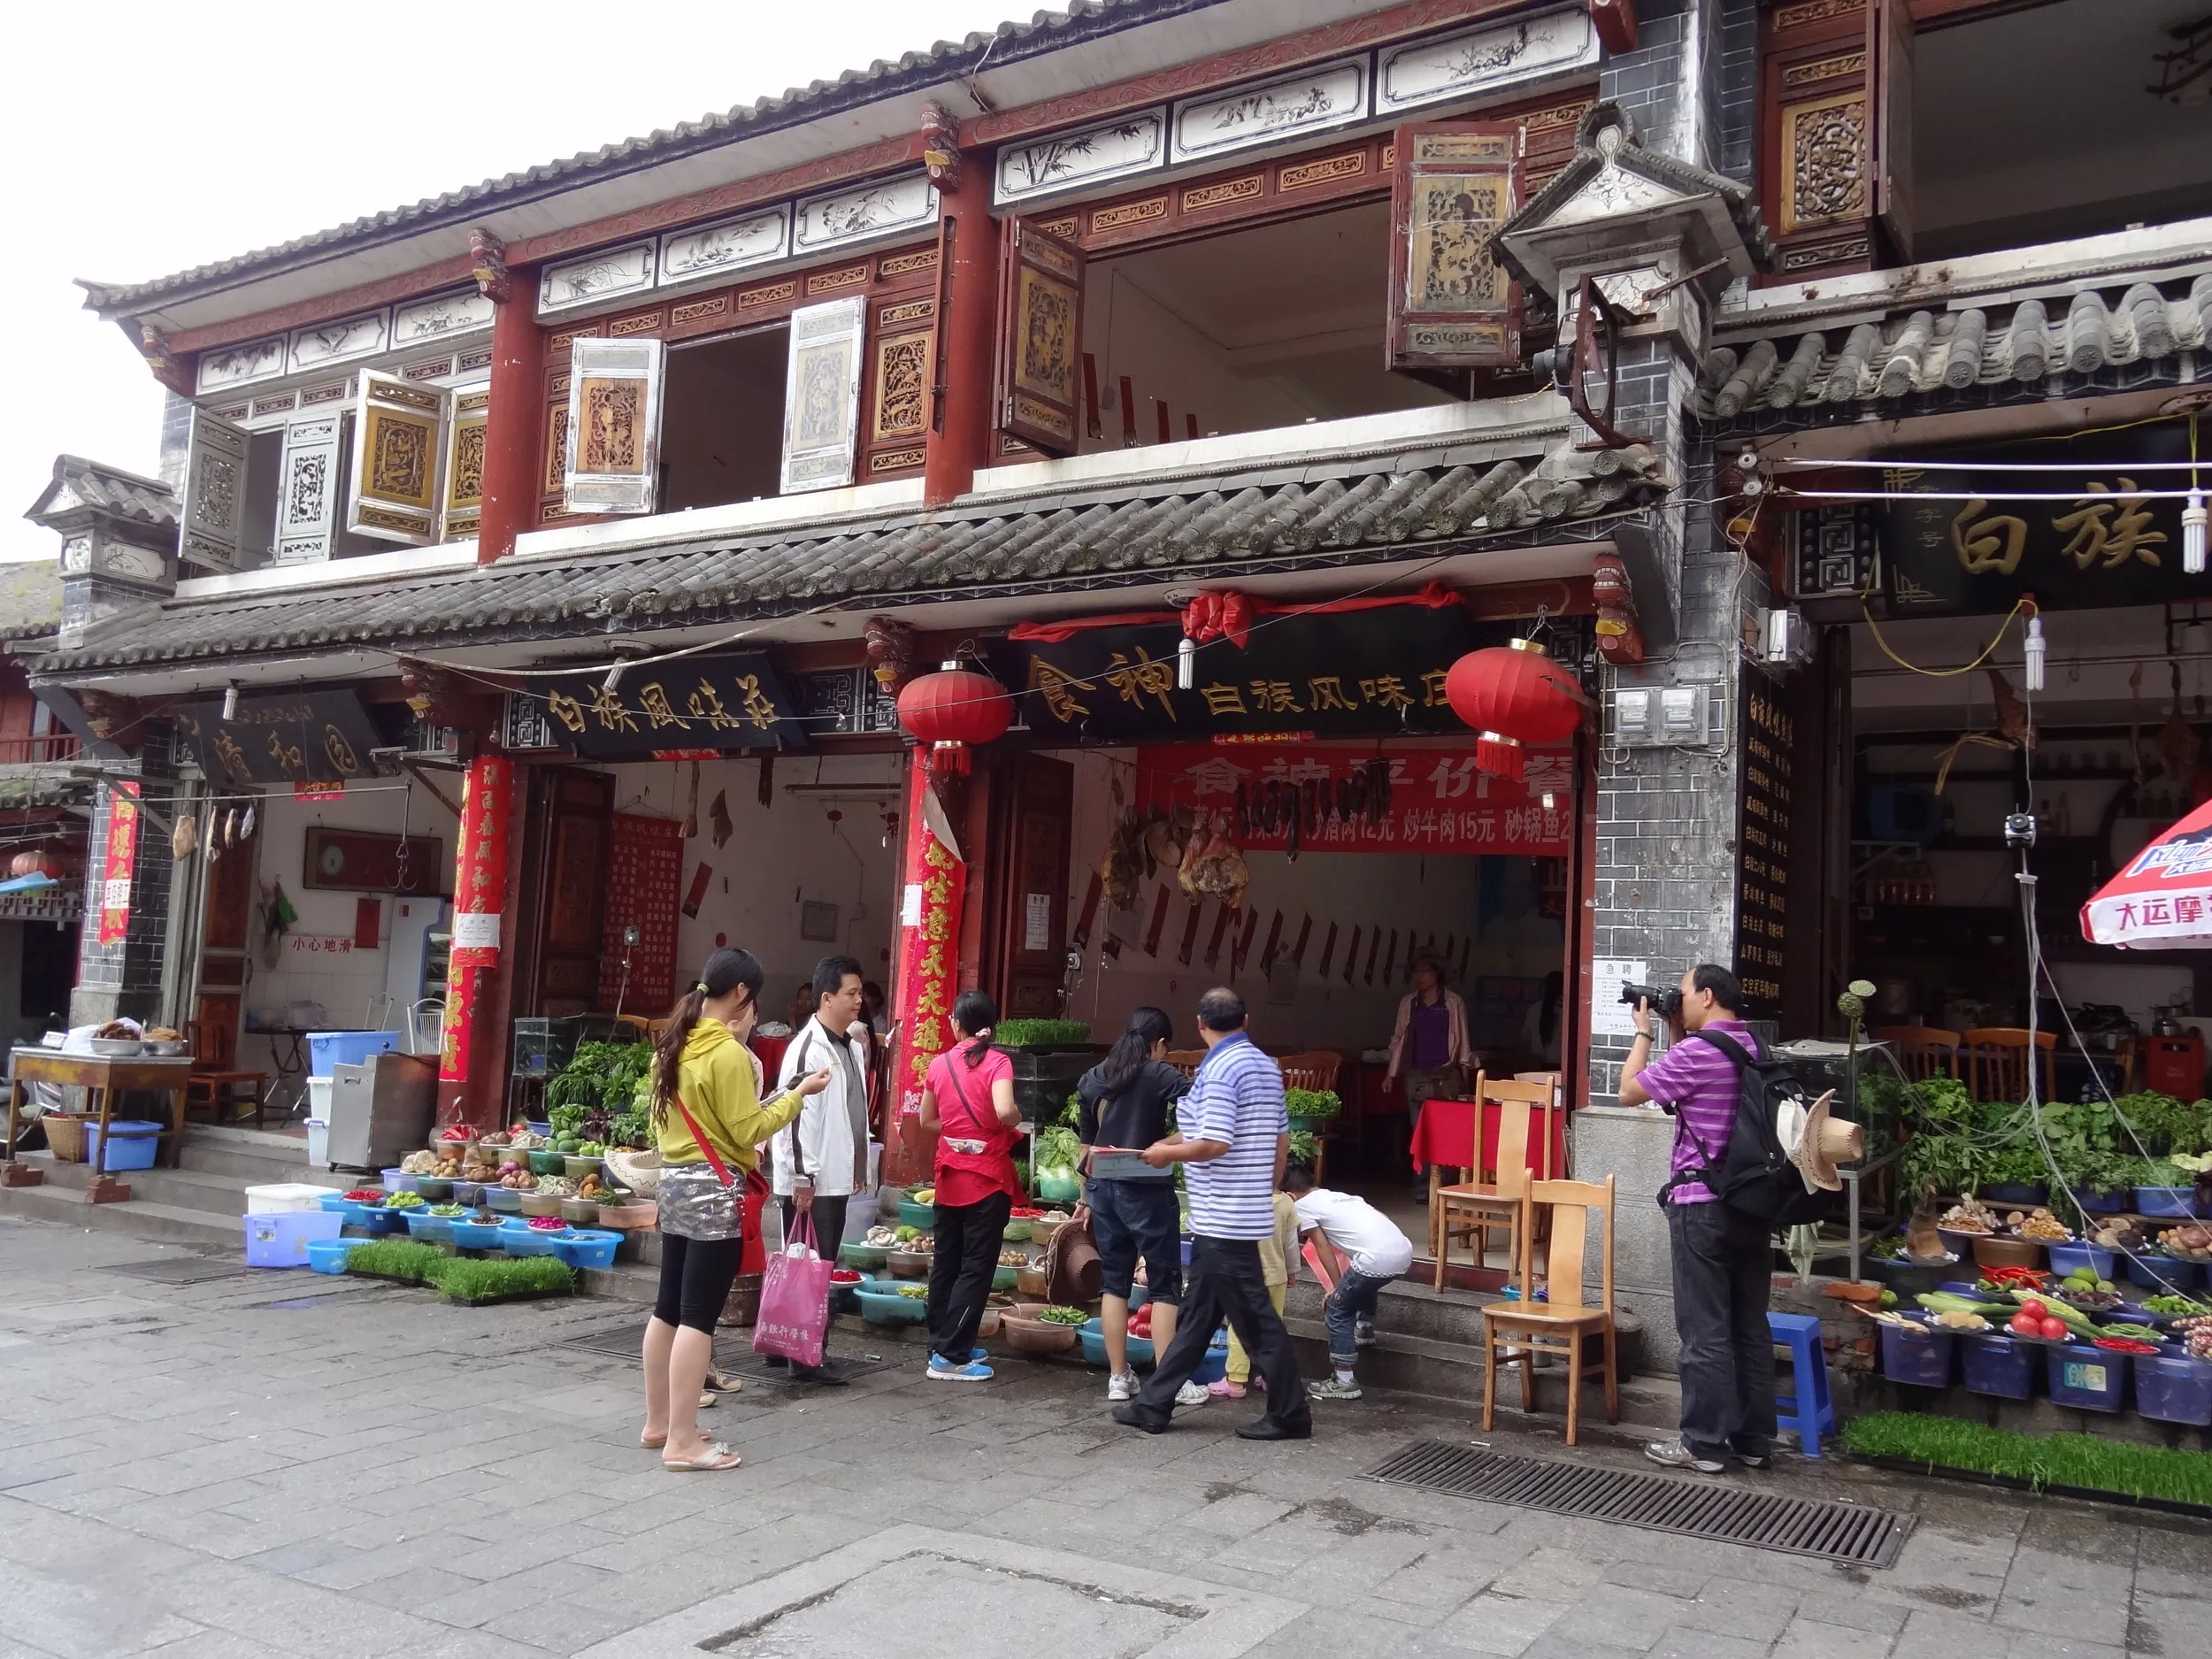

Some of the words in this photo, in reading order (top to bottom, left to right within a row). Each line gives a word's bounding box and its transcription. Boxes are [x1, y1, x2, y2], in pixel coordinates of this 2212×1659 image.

[1951, 477, 2167, 574] 白族
[1026, 645, 1177, 723] 食神
[1402, 806, 1496, 843] 炒牛肉15元
[293, 937, 352, 953] 小心地滑
[1605, 963, 1632, 974] 急聘
